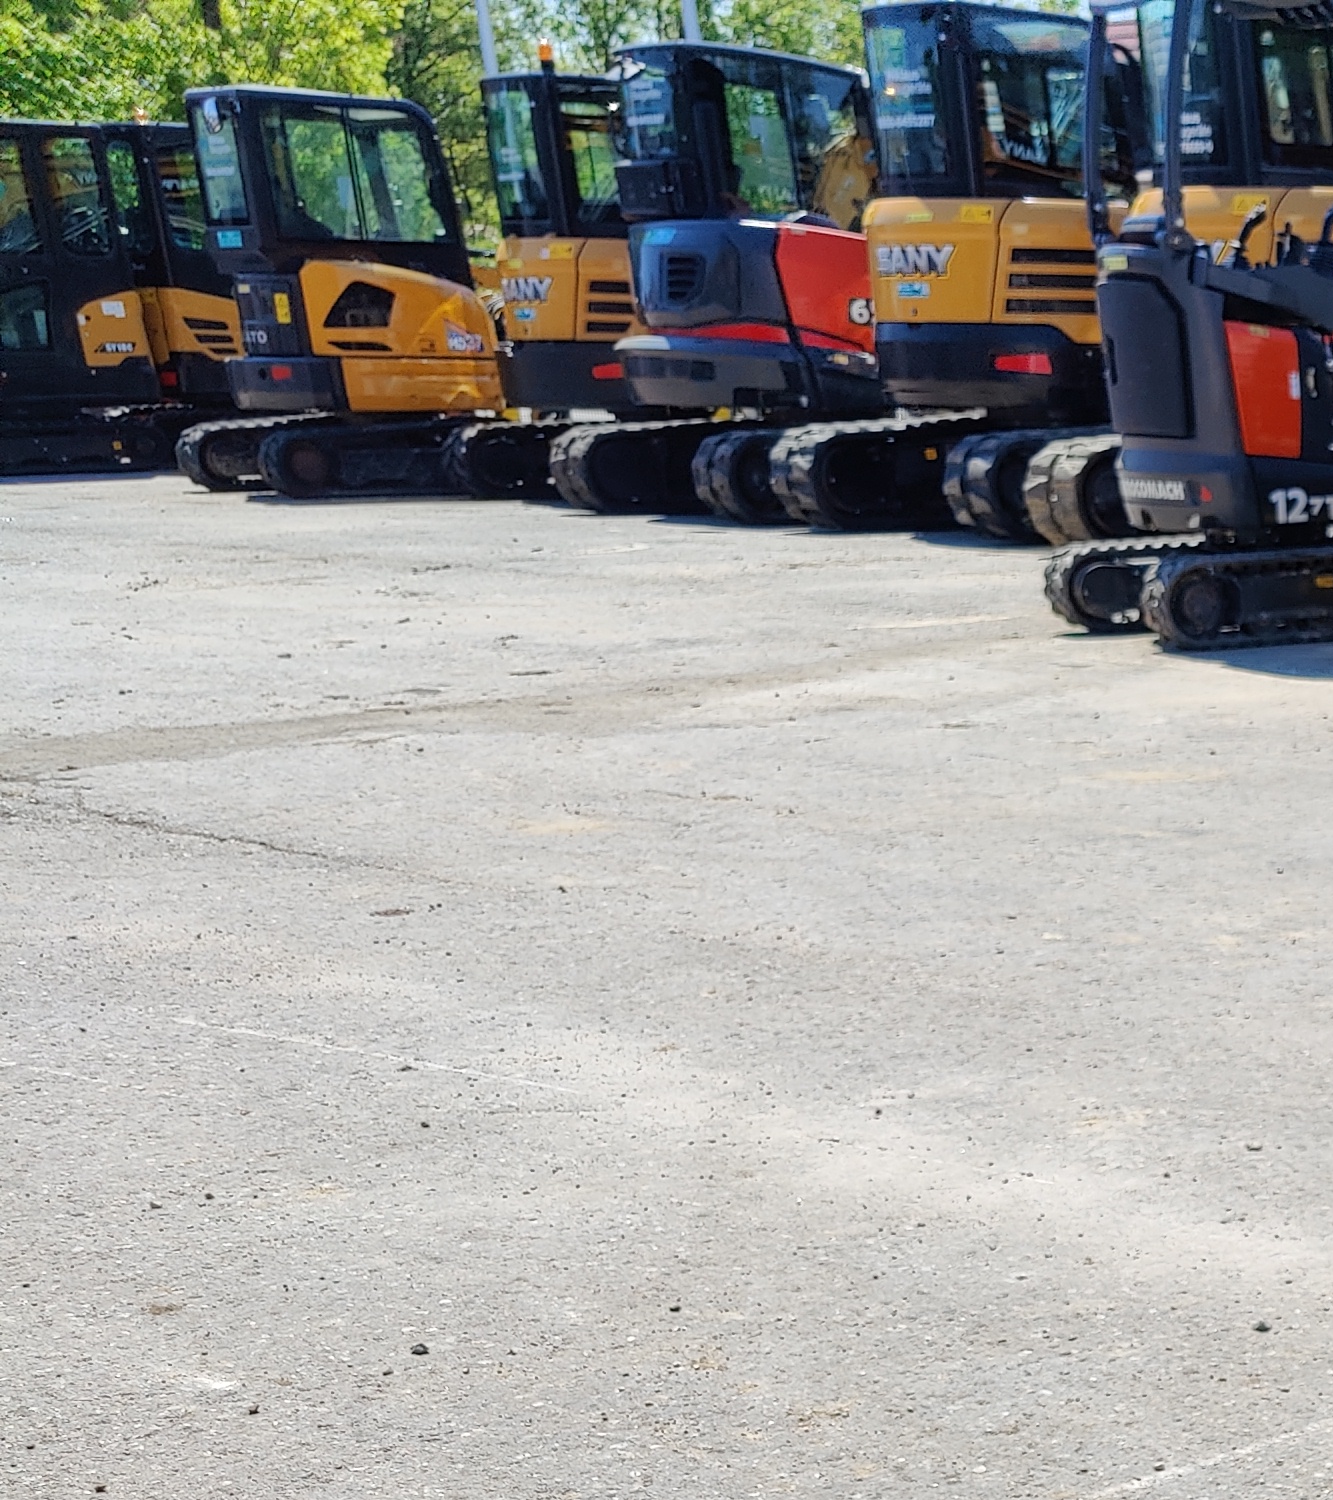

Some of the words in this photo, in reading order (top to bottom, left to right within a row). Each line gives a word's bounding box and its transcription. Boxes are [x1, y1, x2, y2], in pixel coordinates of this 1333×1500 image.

[877, 243, 954, 276] SANY
[501, 276, 553, 301] ANY
[850, 299, 874, 326] 6
[244, 330, 268, 346] ATO
